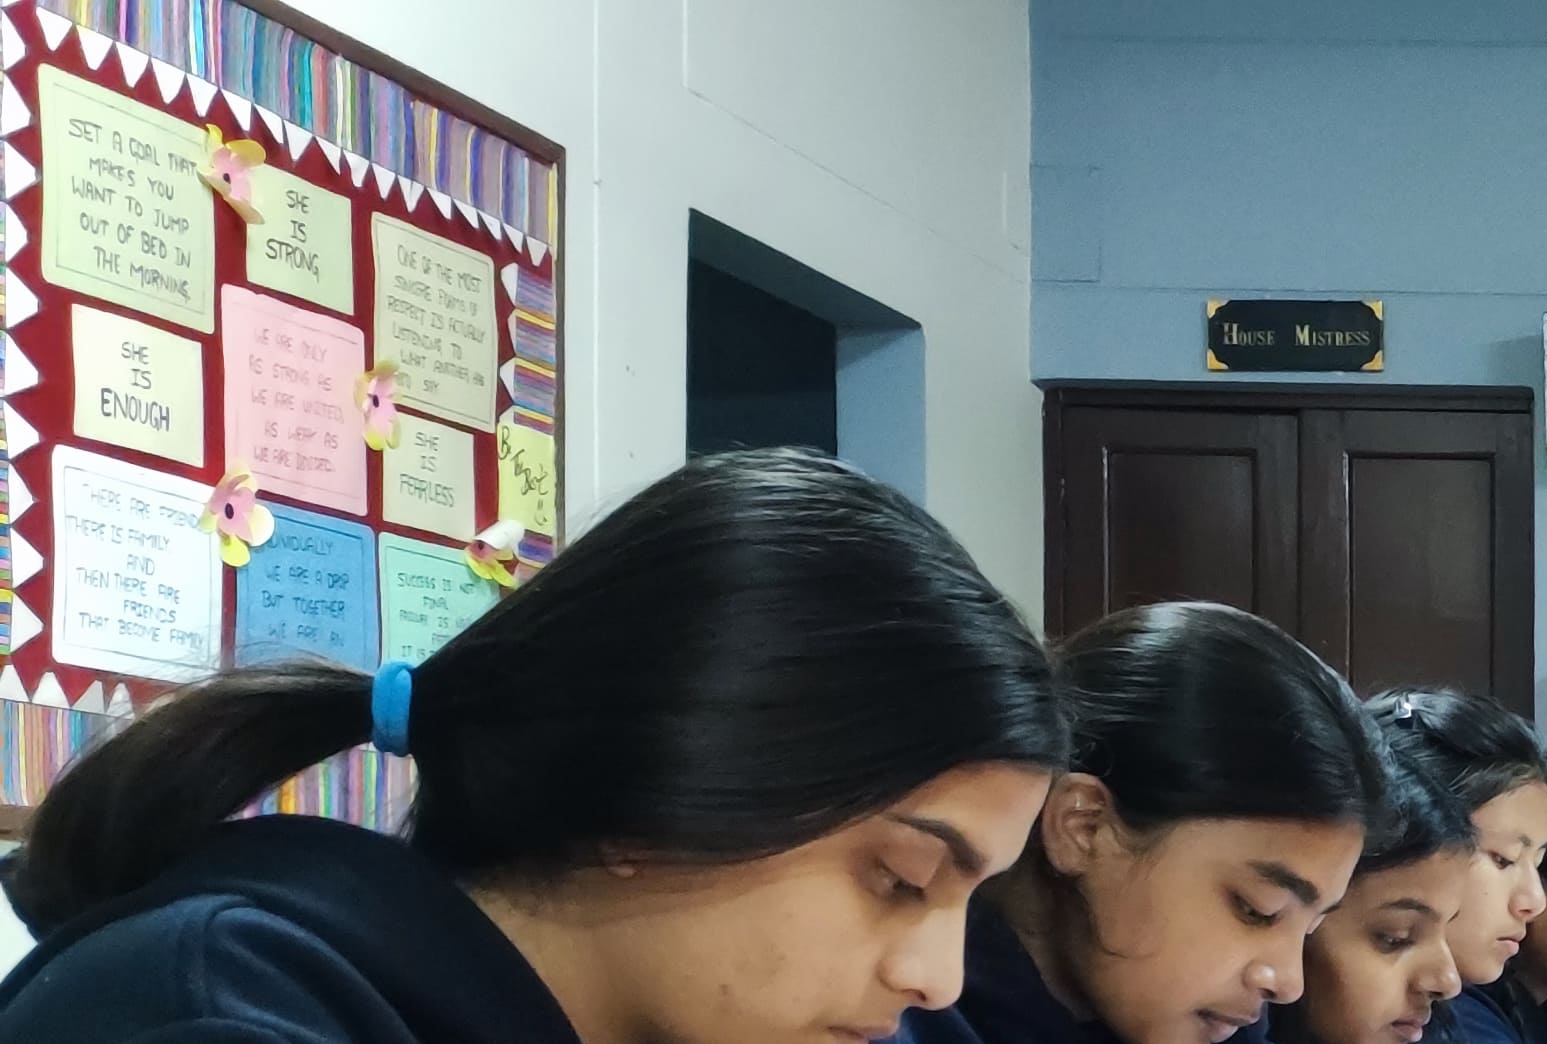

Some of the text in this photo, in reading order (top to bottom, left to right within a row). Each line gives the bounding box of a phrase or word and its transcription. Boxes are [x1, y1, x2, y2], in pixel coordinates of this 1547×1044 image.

[68, 118, 198, 176] SET A GOAL THAT
[89, 158, 174, 200] MAKES YOU
[72, 175, 190, 233] WANT TO JUMP
[286, 190, 310, 214] SHE
[80, 212, 191, 268] OUT OF BED IN
[290, 220, 307, 243] IS
[94, 246, 120, 274] THE
[265, 238, 320, 283] STRONG
[1222, 322, 1371, 346] HOUSE MISTRESS
[121, 341, 149, 365] SHE
[131, 368, 152, 390] IS
[101, 387, 170, 432] ENOUGH
[324, 431, 338, 449] AS
[414, 431, 440, 451] SHE
[420, 455, 437, 472] IS
[400, 473, 455, 508] FEARLESS
[111, 525, 123, 544] IS
[128, 528, 170, 551] FAMILY
[127, 554, 155, 576] AND
[76, 567, 109, 588] THEN
